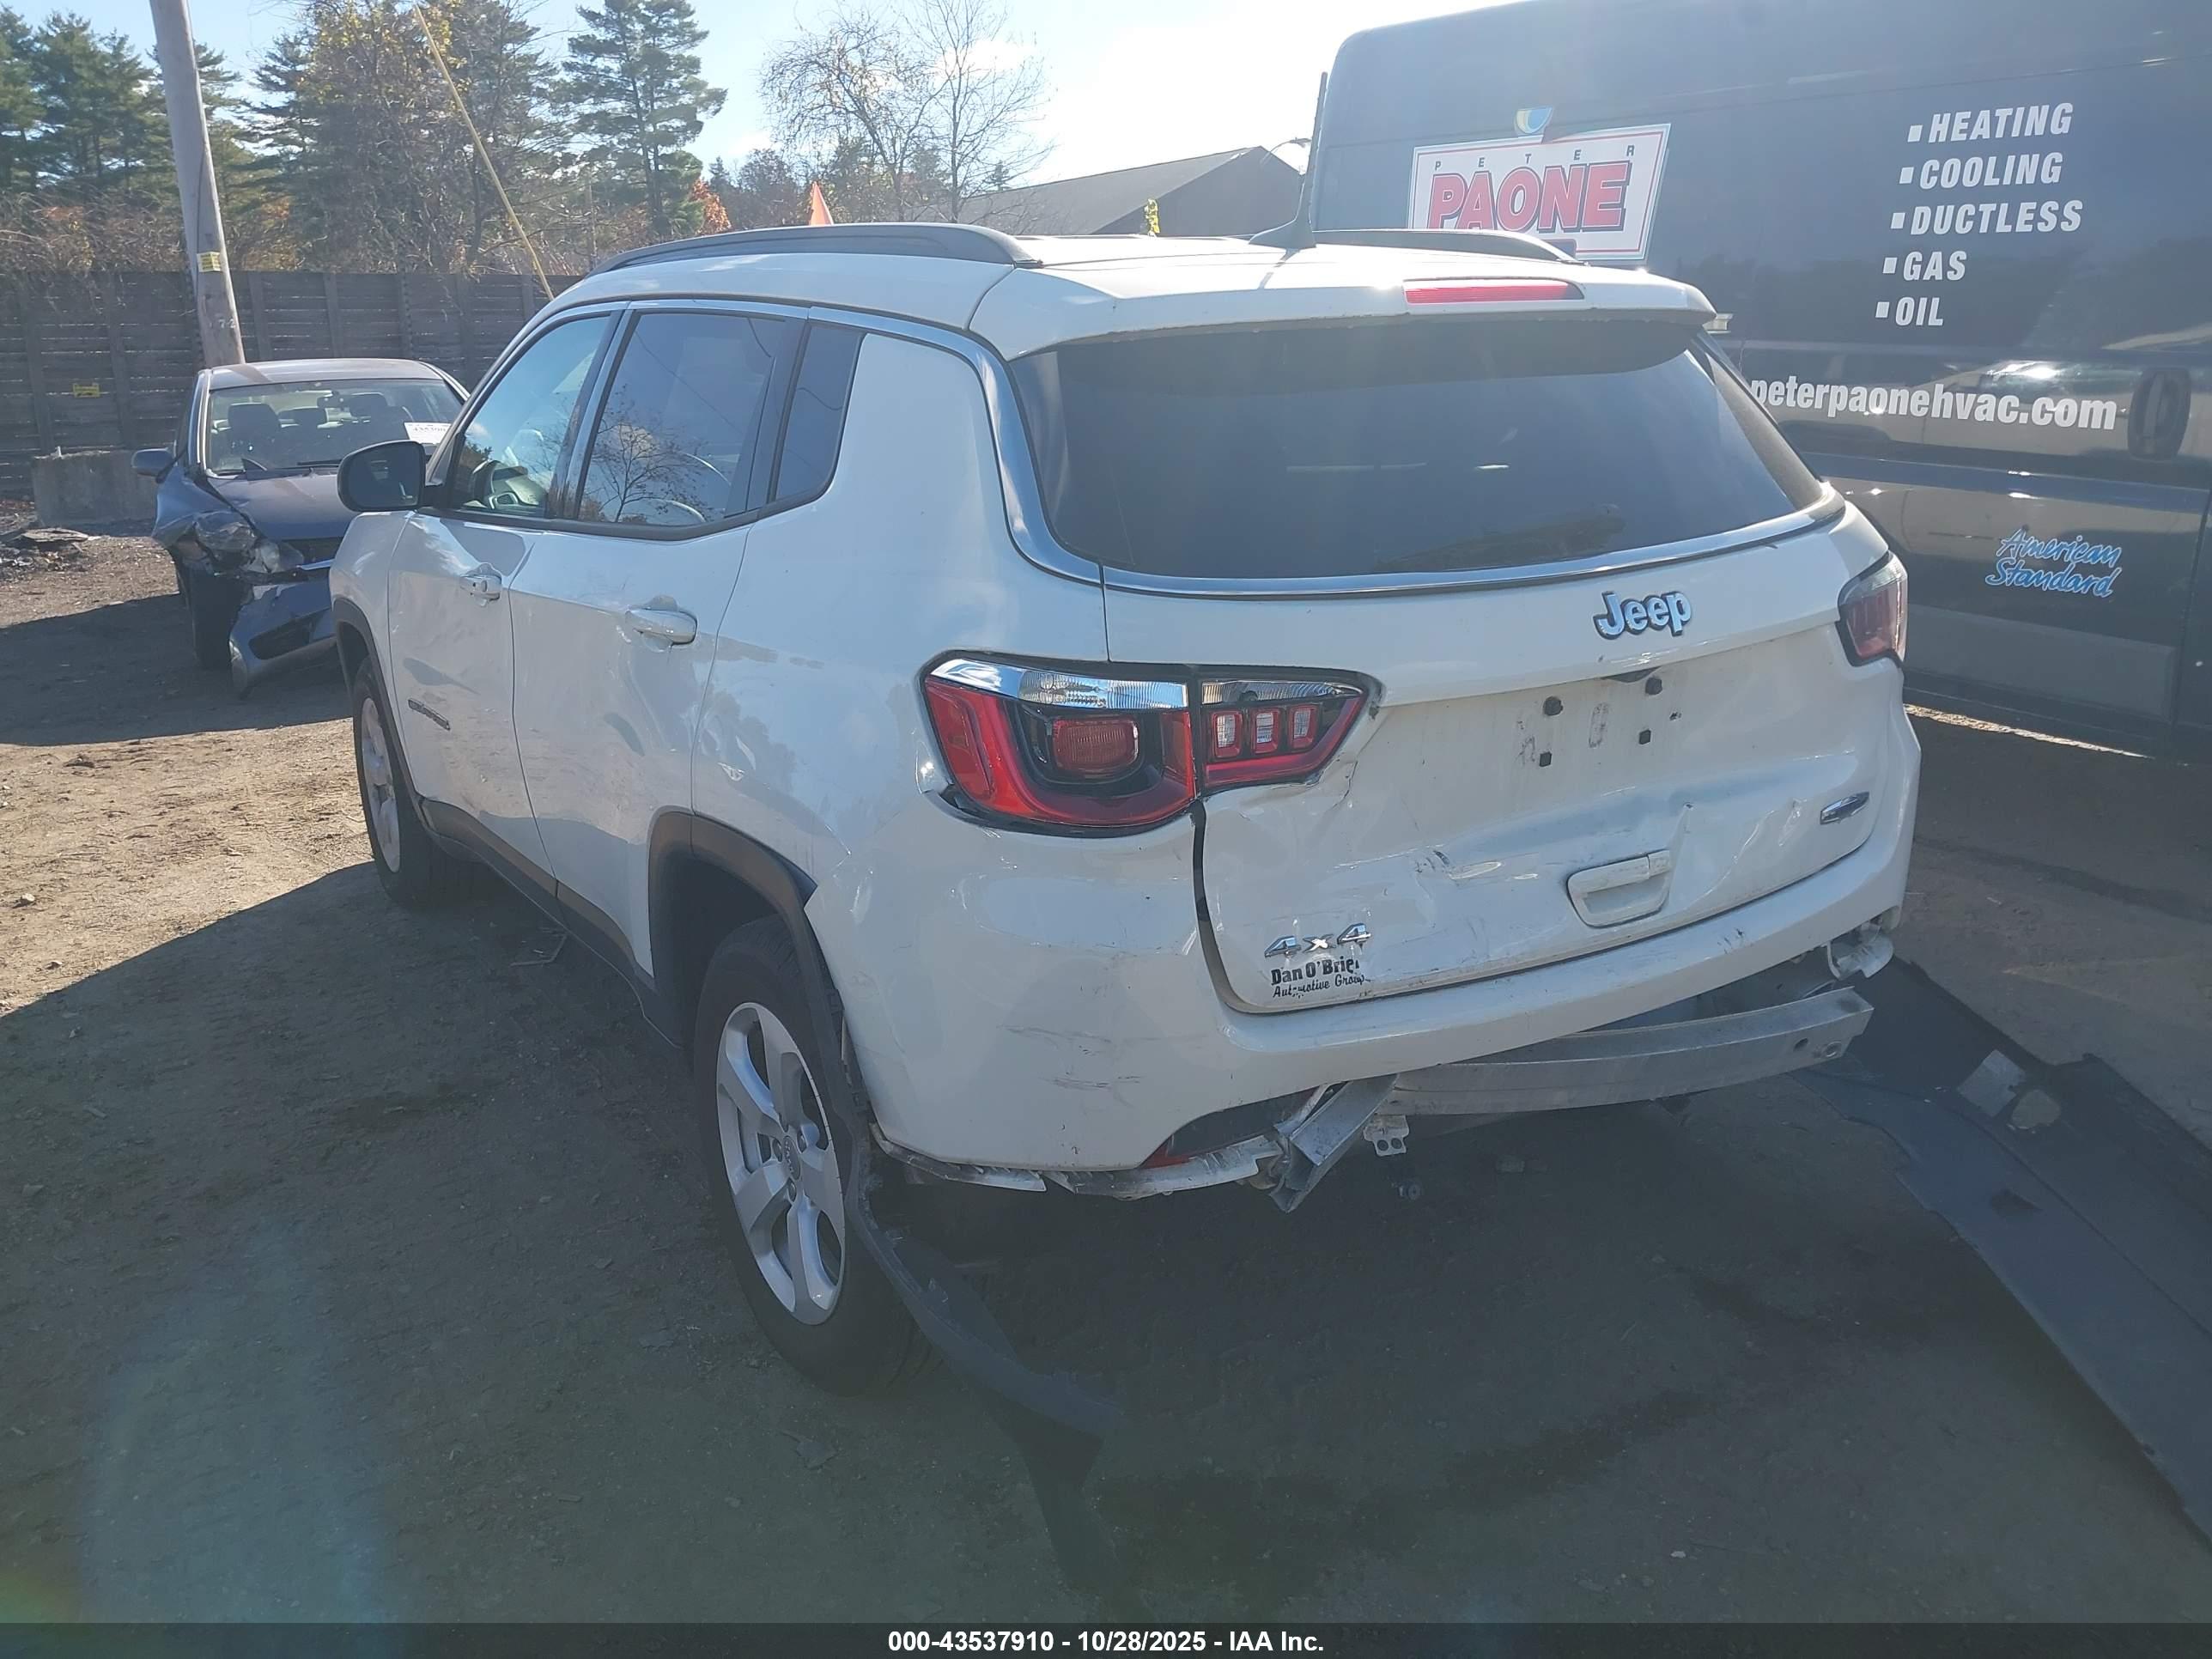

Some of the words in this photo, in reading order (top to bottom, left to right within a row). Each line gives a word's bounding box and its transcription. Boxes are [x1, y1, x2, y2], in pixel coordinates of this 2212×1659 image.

[1928, 102, 2074, 143] HEATING
[1434, 144, 1635, 171] PETER
[1919, 152, 2063, 190] COOLING
[1426, 160, 1632, 233] PAONE
[1910, 199, 2084, 235] DUCTLESS
[1902, 251, 1967, 281] GAS
[1894, 296, 1944, 326] OIL
[1751, 375, 2118, 430] peterpaonehvac.com
[1996, 528, 2122, 568] American
[1985, 557, 2123, 598] Standard
[1593, 590, 1692, 640] Jeep
[1271, 968, 1303, 986] Dan
